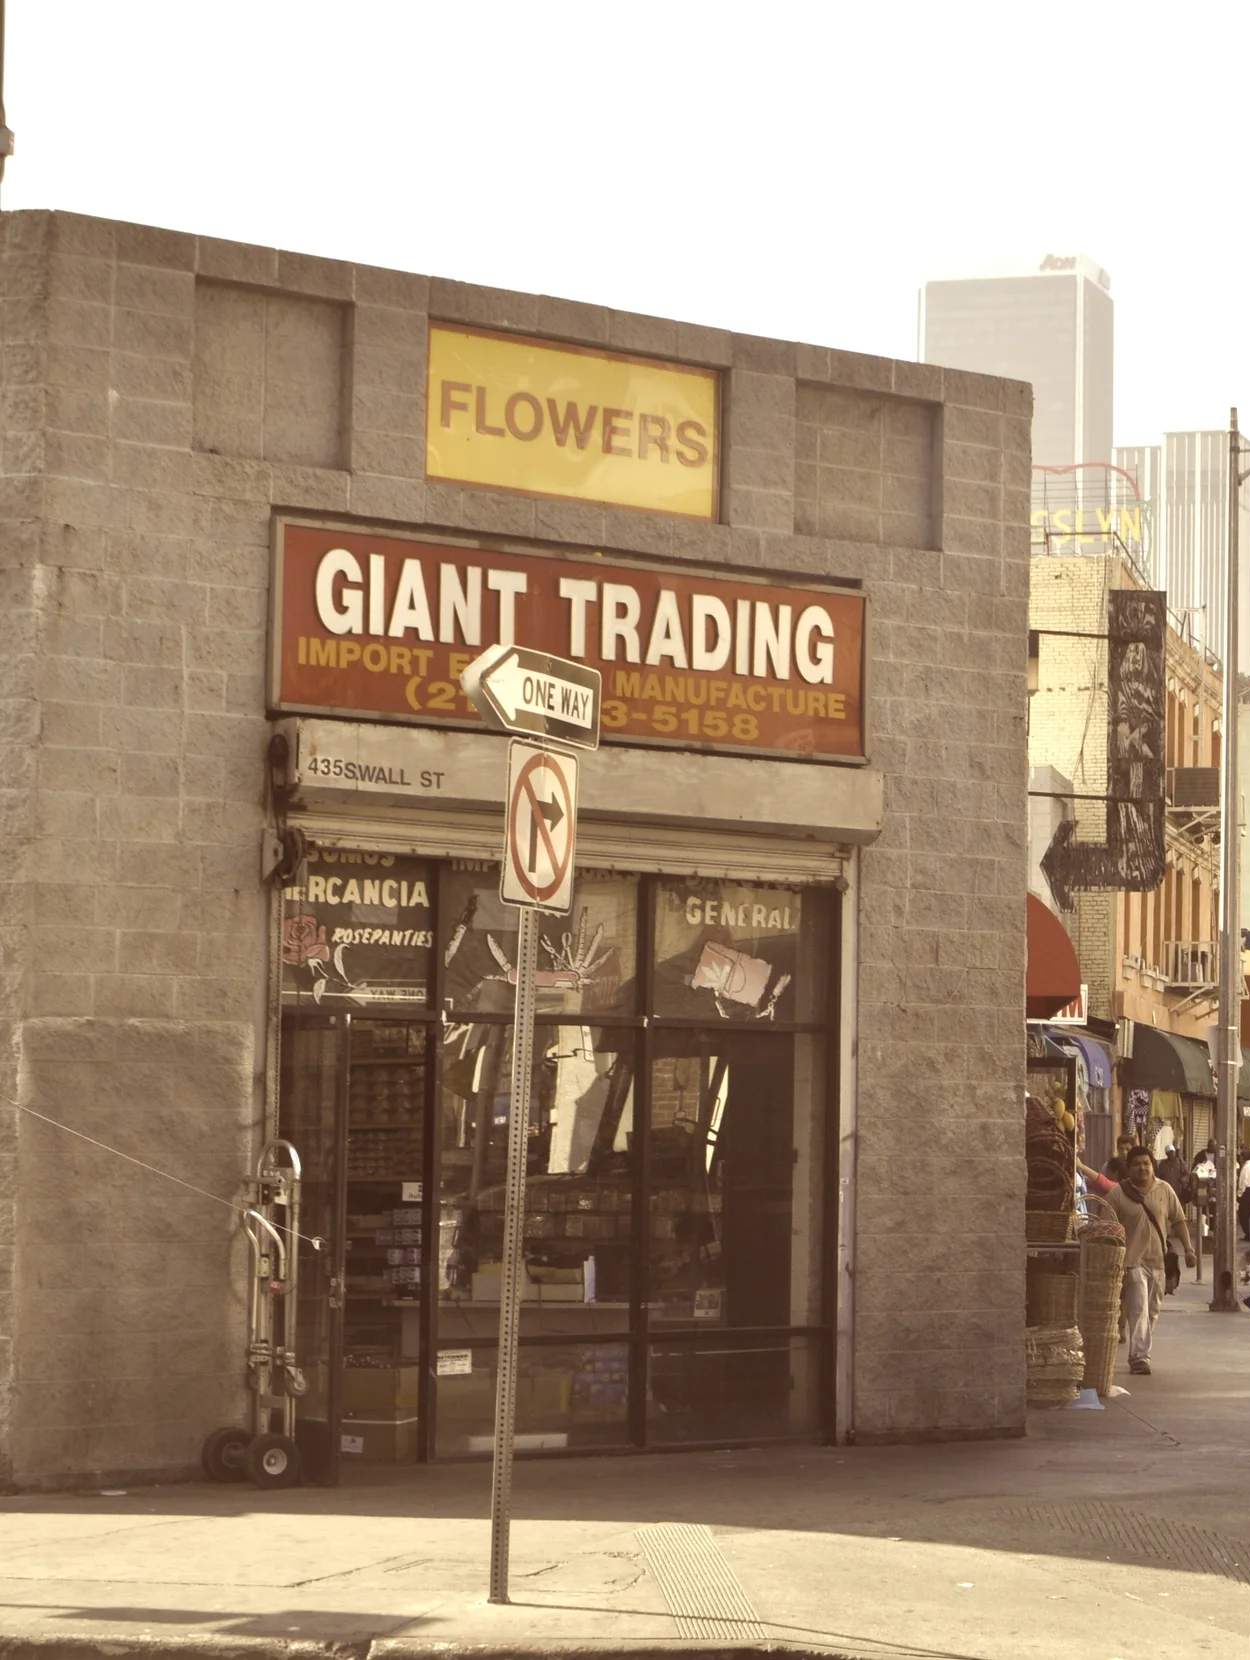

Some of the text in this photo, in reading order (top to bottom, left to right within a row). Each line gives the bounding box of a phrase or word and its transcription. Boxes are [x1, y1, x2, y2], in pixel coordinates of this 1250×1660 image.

[440, 379, 708, 469] FLOWERS
[316, 548, 835, 685] GIANT TRADING
[298, 636, 433, 677] IMPORT
[522, 676, 589, 721] ONE WAY
[615, 670, 846, 720] MANUFACTURE
[420, 770, 445, 790] ST
